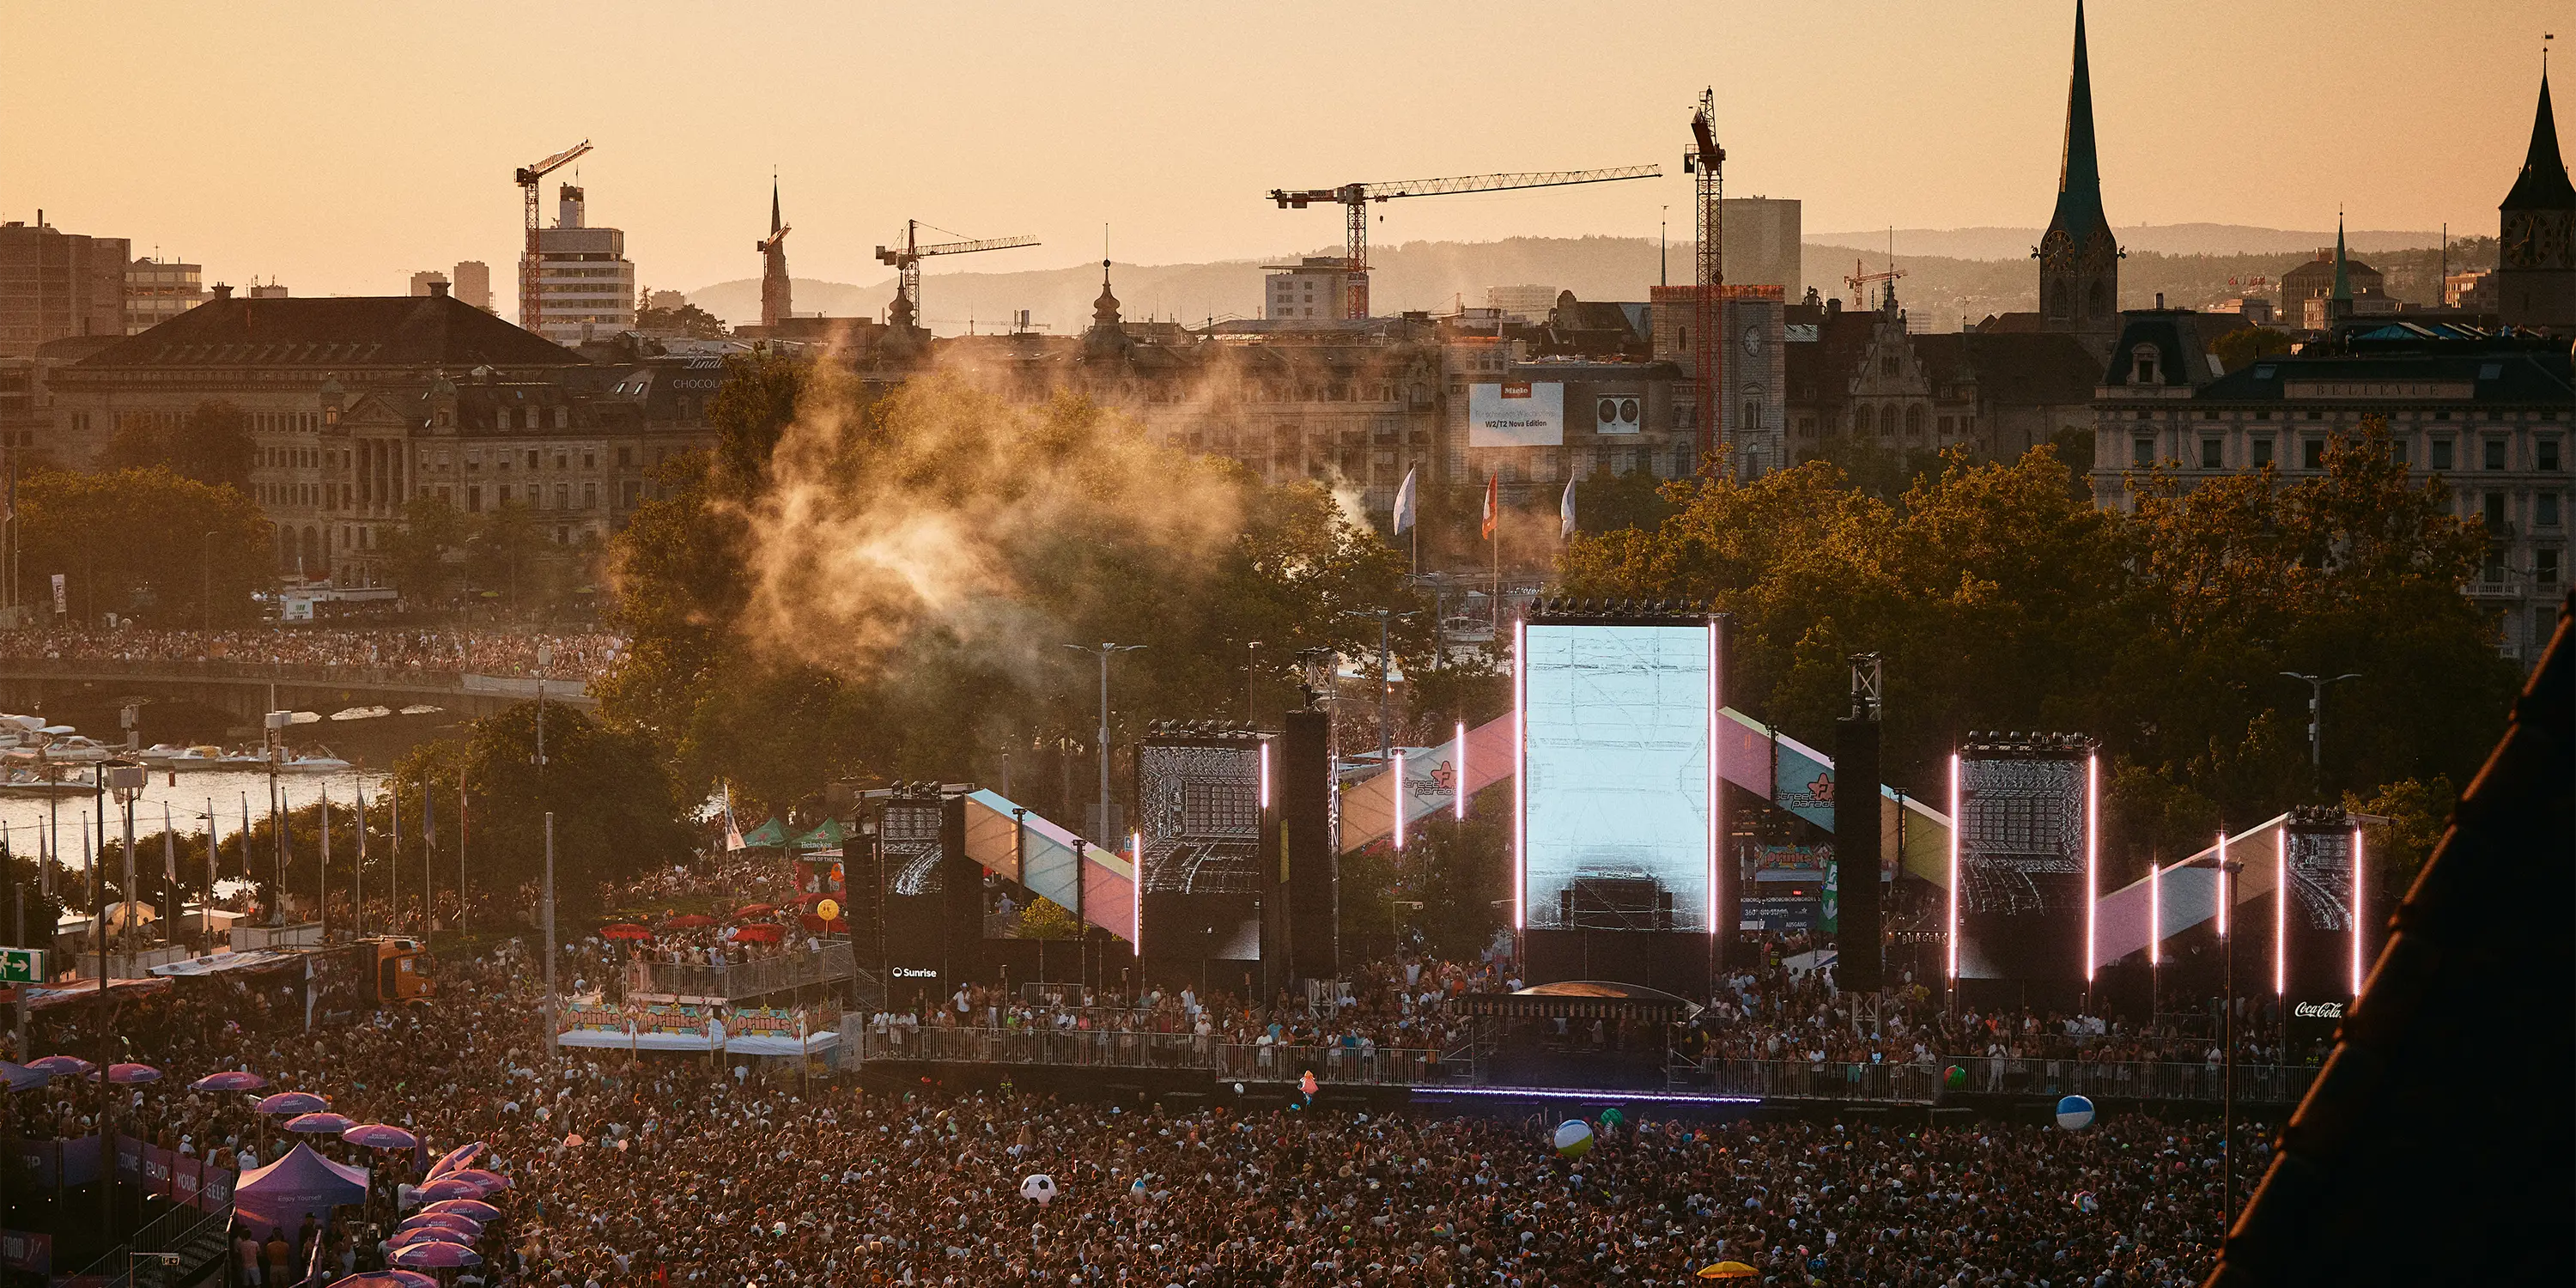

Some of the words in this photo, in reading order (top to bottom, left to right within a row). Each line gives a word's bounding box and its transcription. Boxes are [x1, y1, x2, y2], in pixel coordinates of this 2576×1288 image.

[2317, 385, 2439, 396] BELLEVUE
[1485, 421, 1508, 429] W2/T2
[1526, 419, 1547, 428] Edition
[1401, 777, 1440, 787] treet
[1766, 851, 1811, 863] Drinks
[1902, 933, 1947, 945] BURGERS
[903, 968, 937, 978] Sunrise
[2294, 1001, 2343, 1018] Coca-Cola
[569, 1010, 621, 1024] Drinks
[647, 1012, 700, 1028] Drinks
[736, 1016, 790, 1030] Drinks
[119, 1151, 138, 1172] ZONE
[176, 1171, 197, 1192] YOUR
[3, 1236, 24, 1259] FOOD
